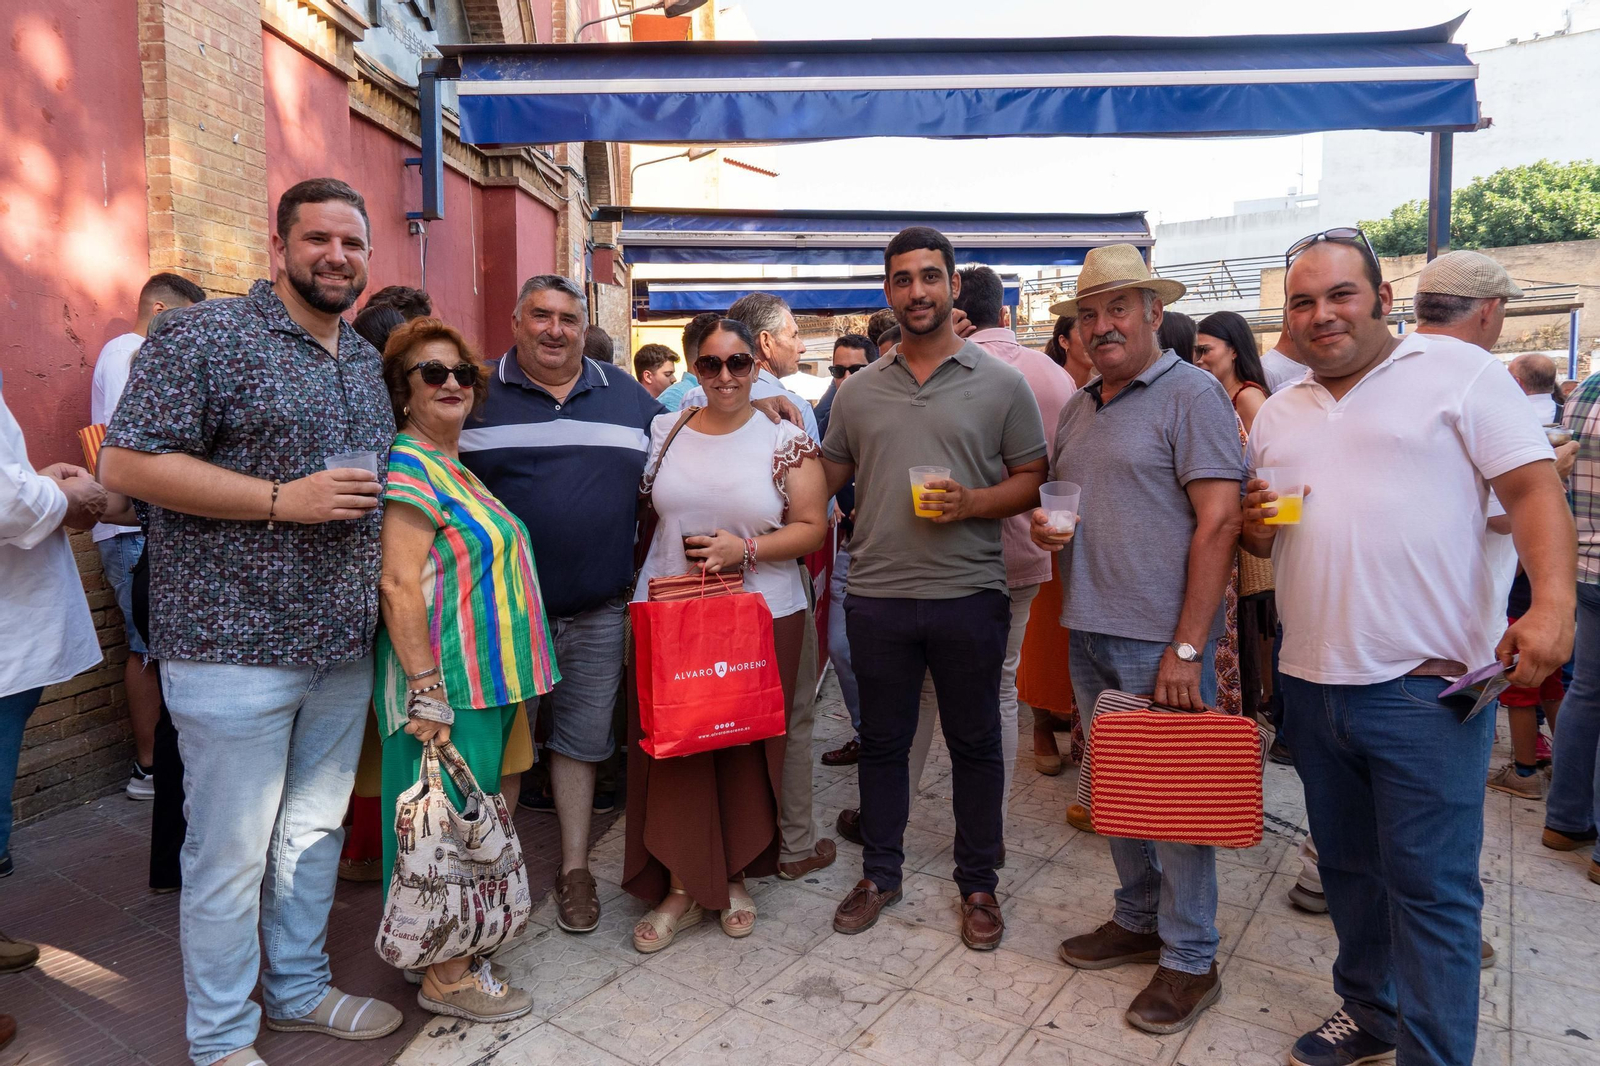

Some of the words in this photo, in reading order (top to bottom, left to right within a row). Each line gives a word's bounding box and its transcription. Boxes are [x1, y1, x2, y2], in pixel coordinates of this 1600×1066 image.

[674, 668, 713, 681] ALVARO
[729, 659, 767, 673] MORENO
[392, 929, 419, 941] Guards
